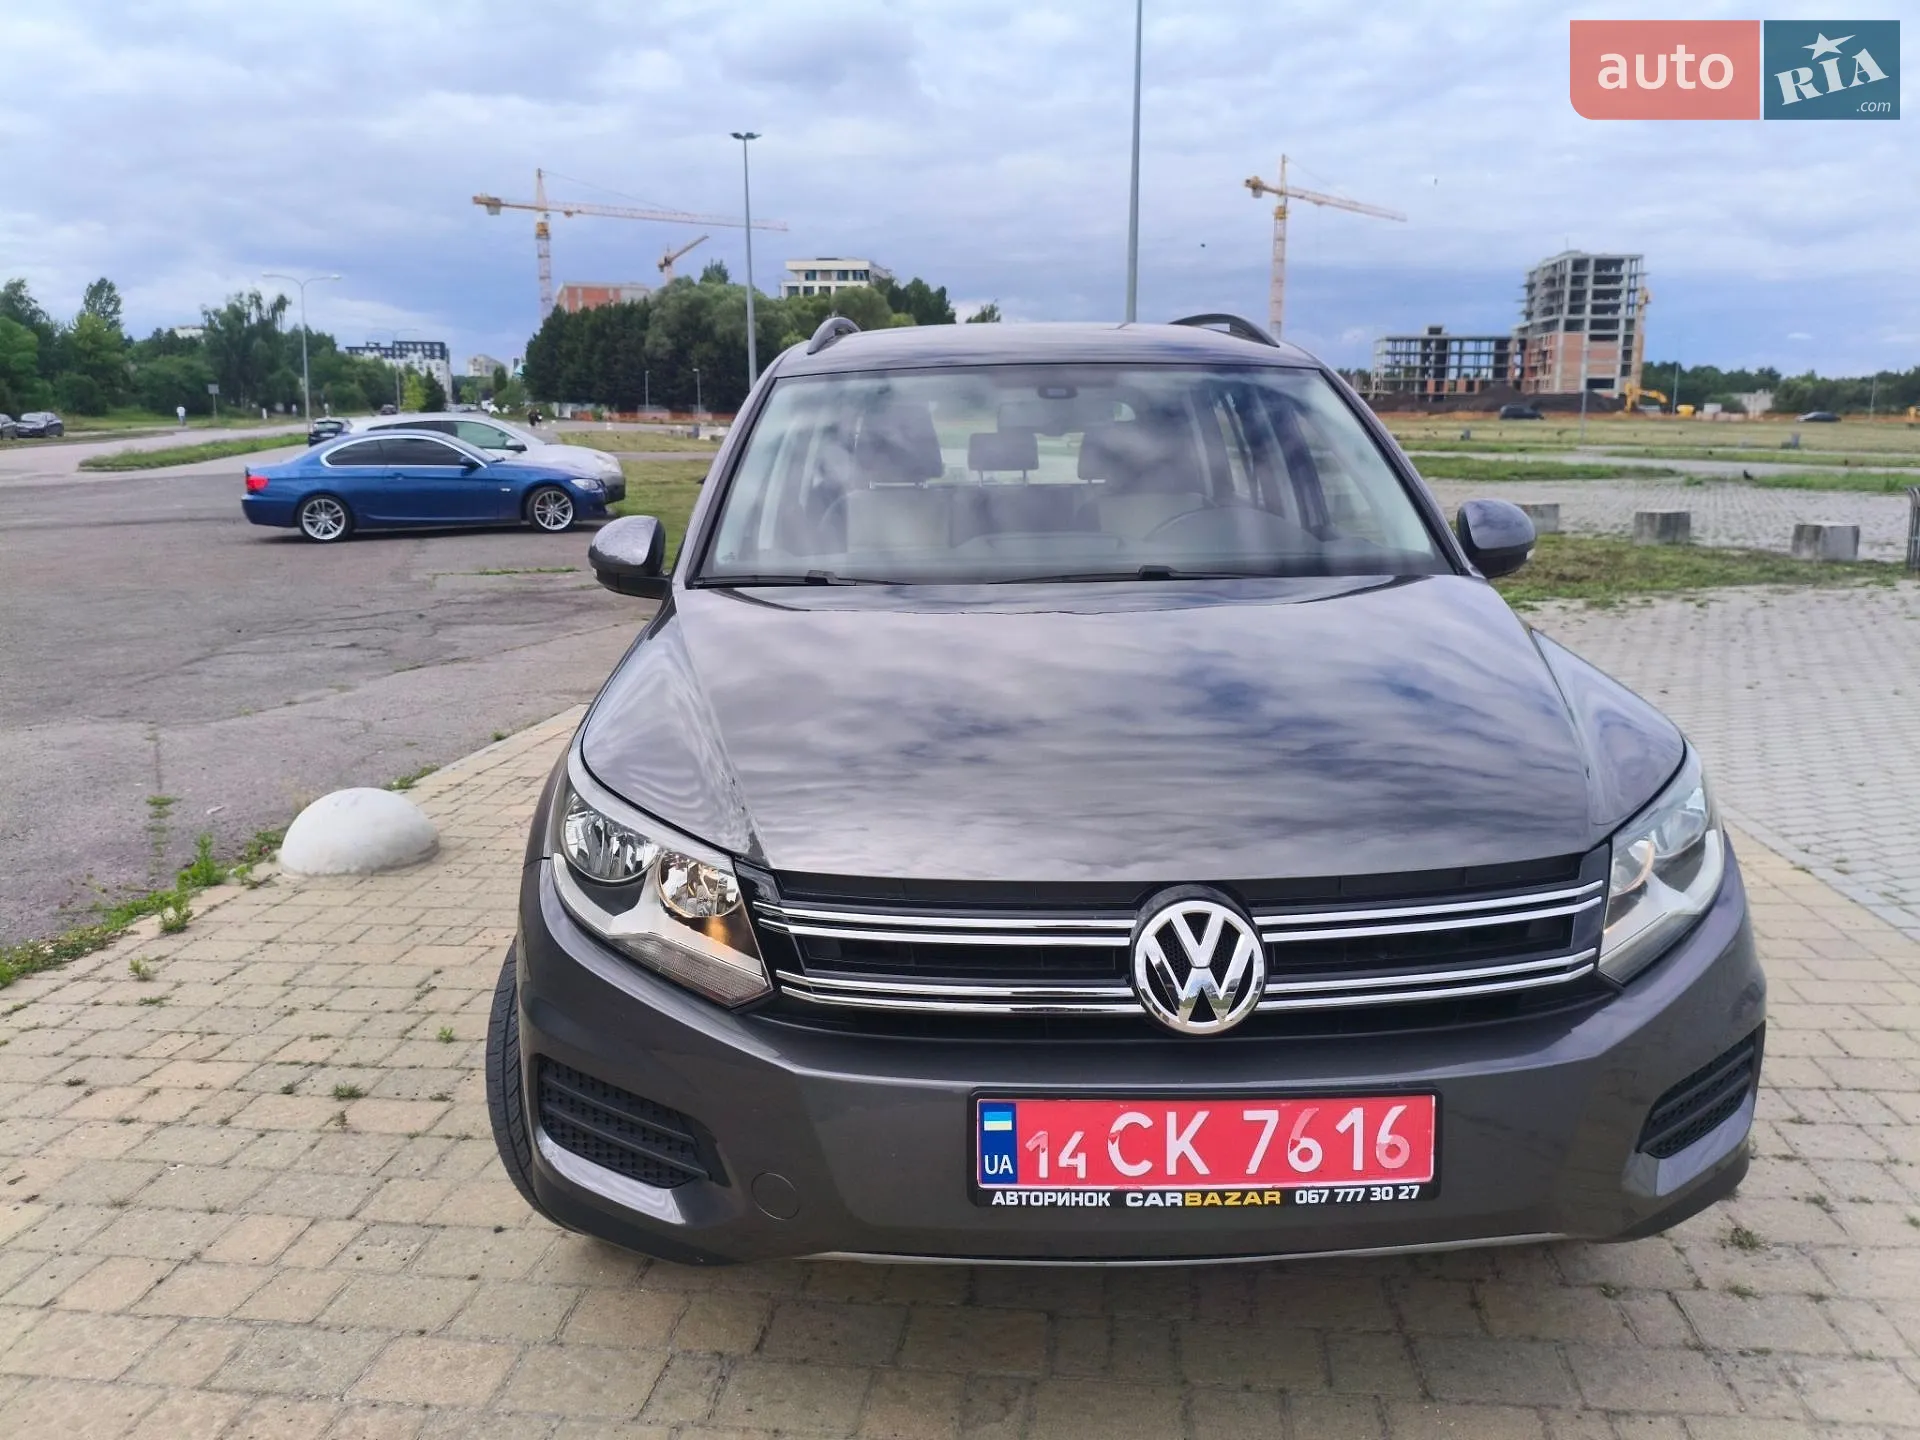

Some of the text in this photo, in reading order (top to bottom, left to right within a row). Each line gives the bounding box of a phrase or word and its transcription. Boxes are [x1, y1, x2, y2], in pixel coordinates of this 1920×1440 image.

[1138, 903, 1262, 1033] VW
[984, 1155, 1013, 1175] UA
[1026, 1105, 1411, 1179] 14 CK 7616
[992, 1185, 1420, 1207] АВТОРИНОК CARBAZAR 067 777 30 27
